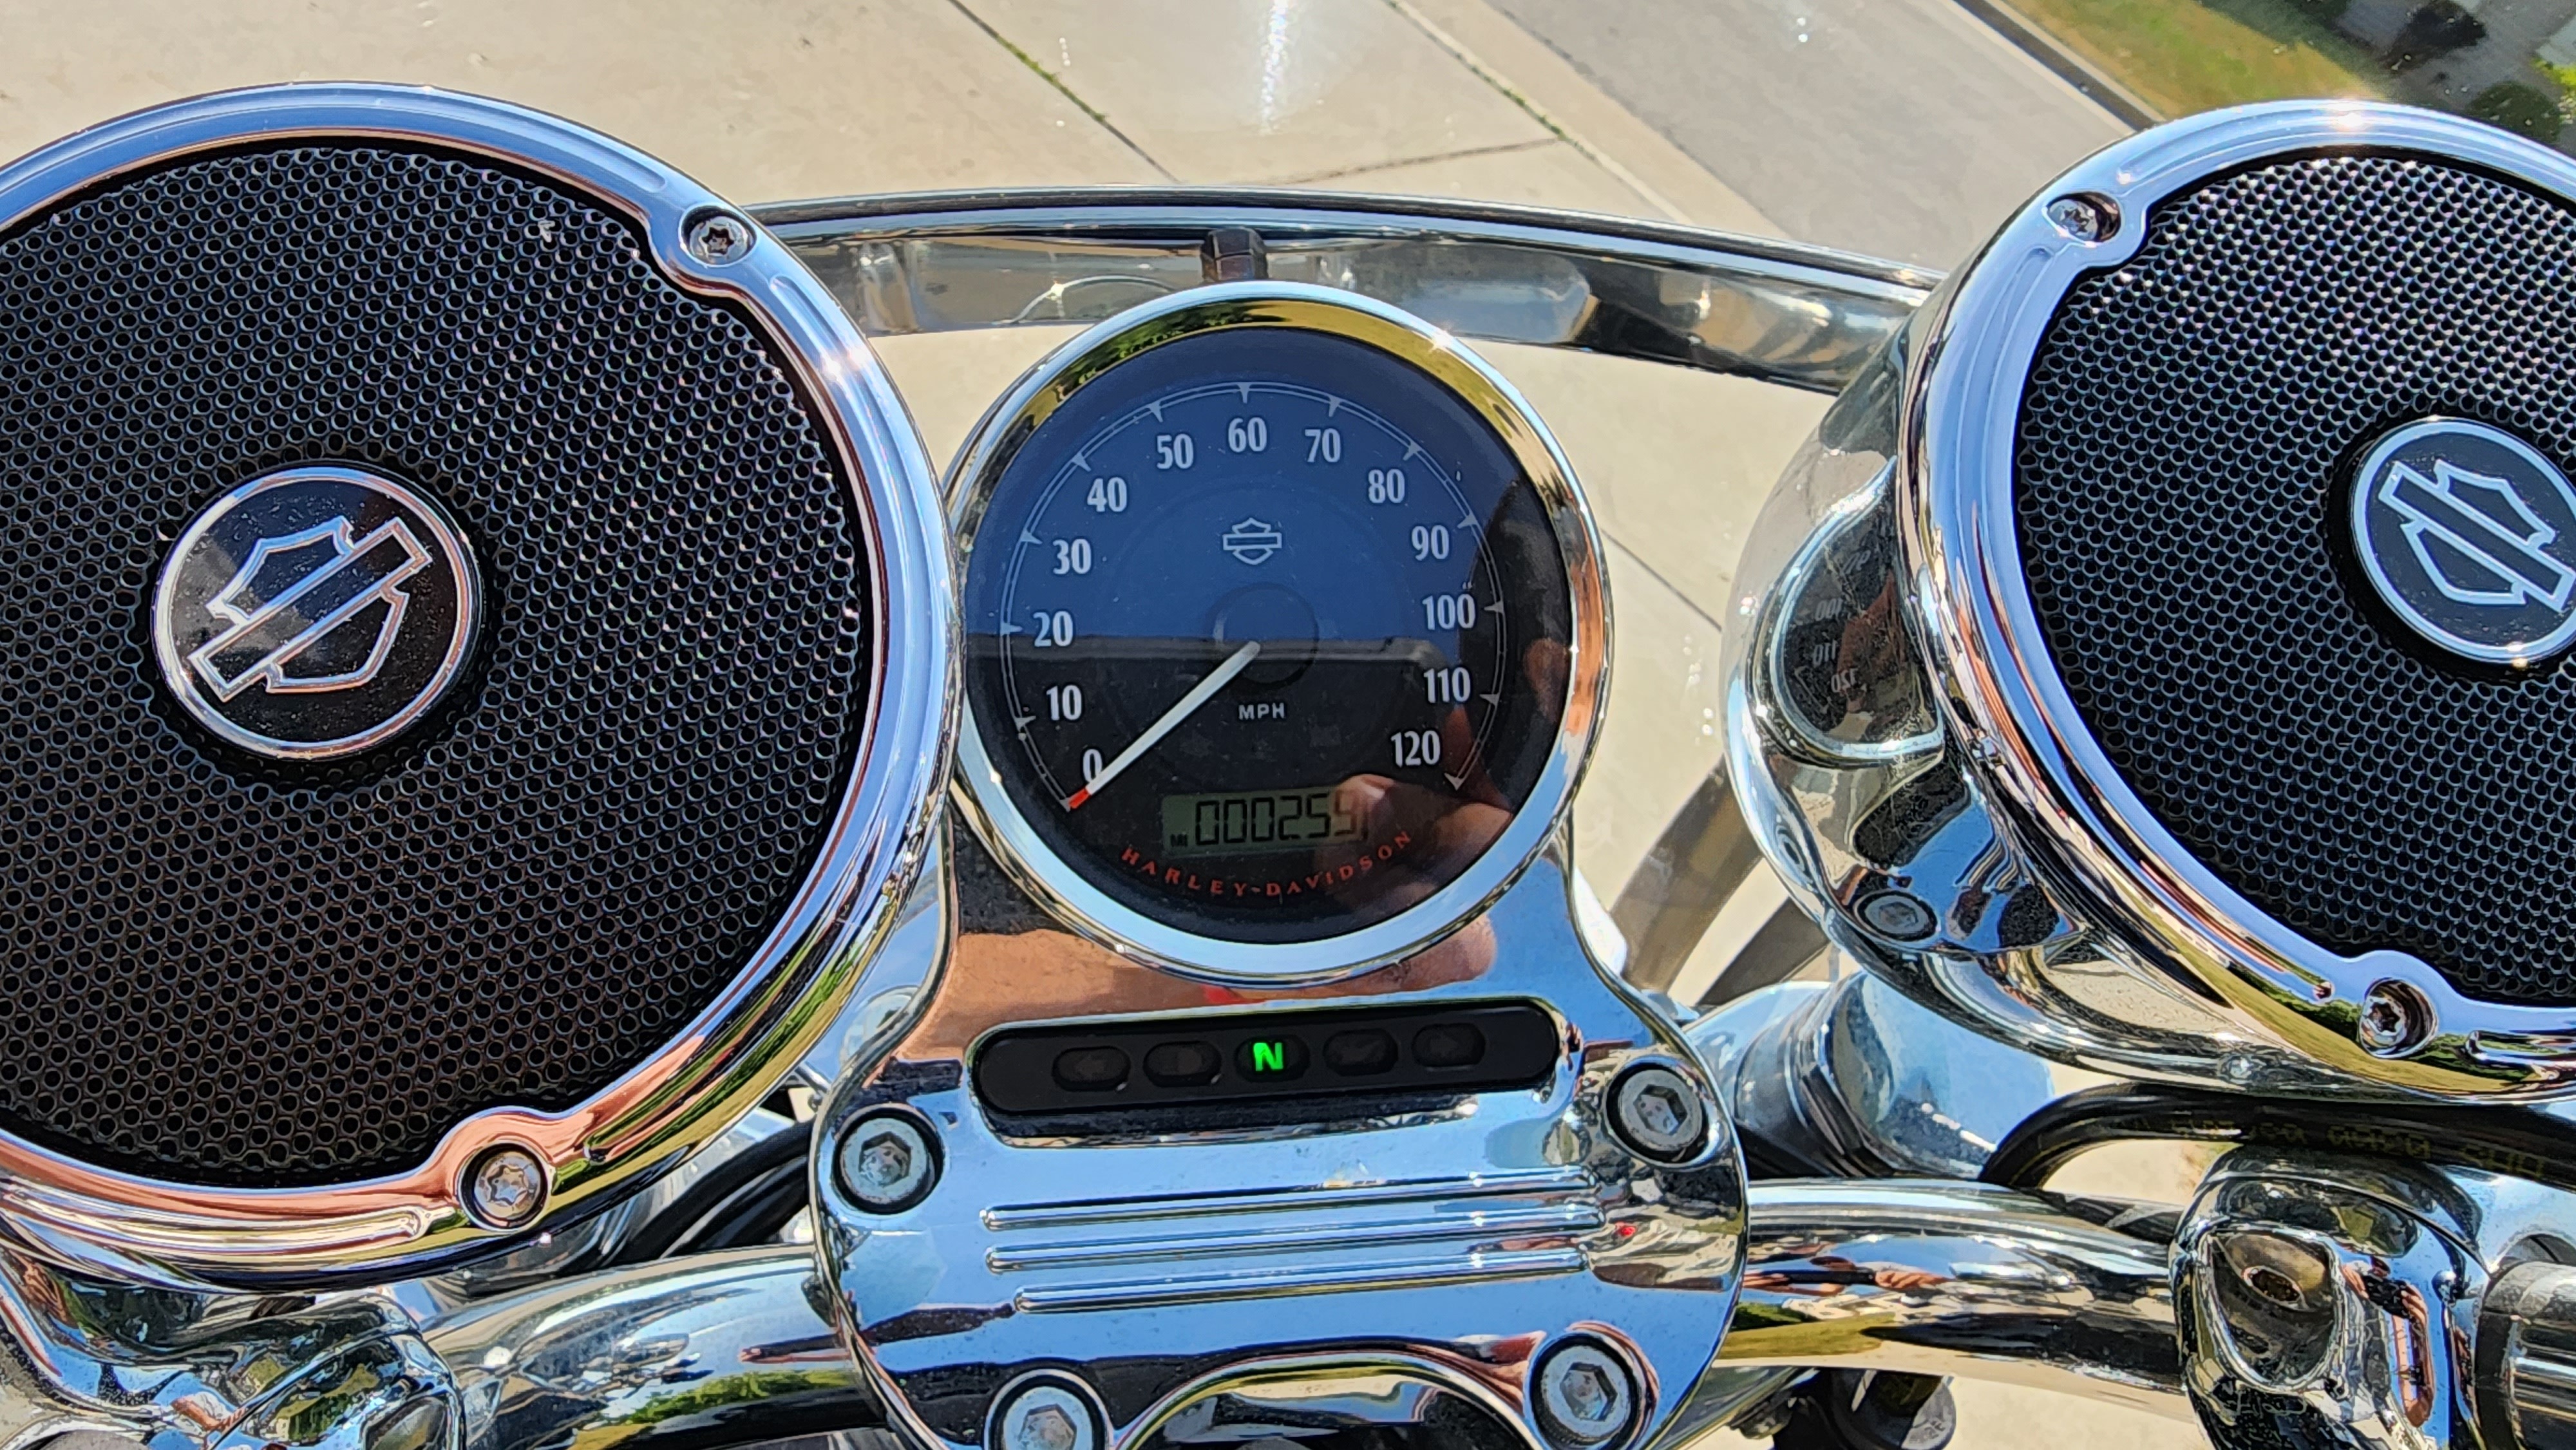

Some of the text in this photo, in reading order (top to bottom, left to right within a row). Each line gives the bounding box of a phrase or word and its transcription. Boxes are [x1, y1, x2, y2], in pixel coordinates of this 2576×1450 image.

[1227, 417, 1267, 451] 60
[1305, 429, 1341, 462] 70
[1157, 435, 1194, 469] 50
[1087, 477, 1127, 512] 40
[1367, 470, 1406, 503] 80
[1052, 540, 1091, 574] 30
[1412, 525, 1450, 560] 90
[1422, 594, 1475, 628] 100
[1034, 612, 1074, 647] 20
[1046, 685, 1082, 720] 10
[1423, 668, 1471, 703] 110
[1238, 702, 1285, 720] MPH
[1082, 748, 1103, 782] 0
[1391, 731, 1441, 766] 120
[1121, 831, 1411, 896] HARLEY-DAVIDSON
[1253, 1042, 1283, 1071] N
